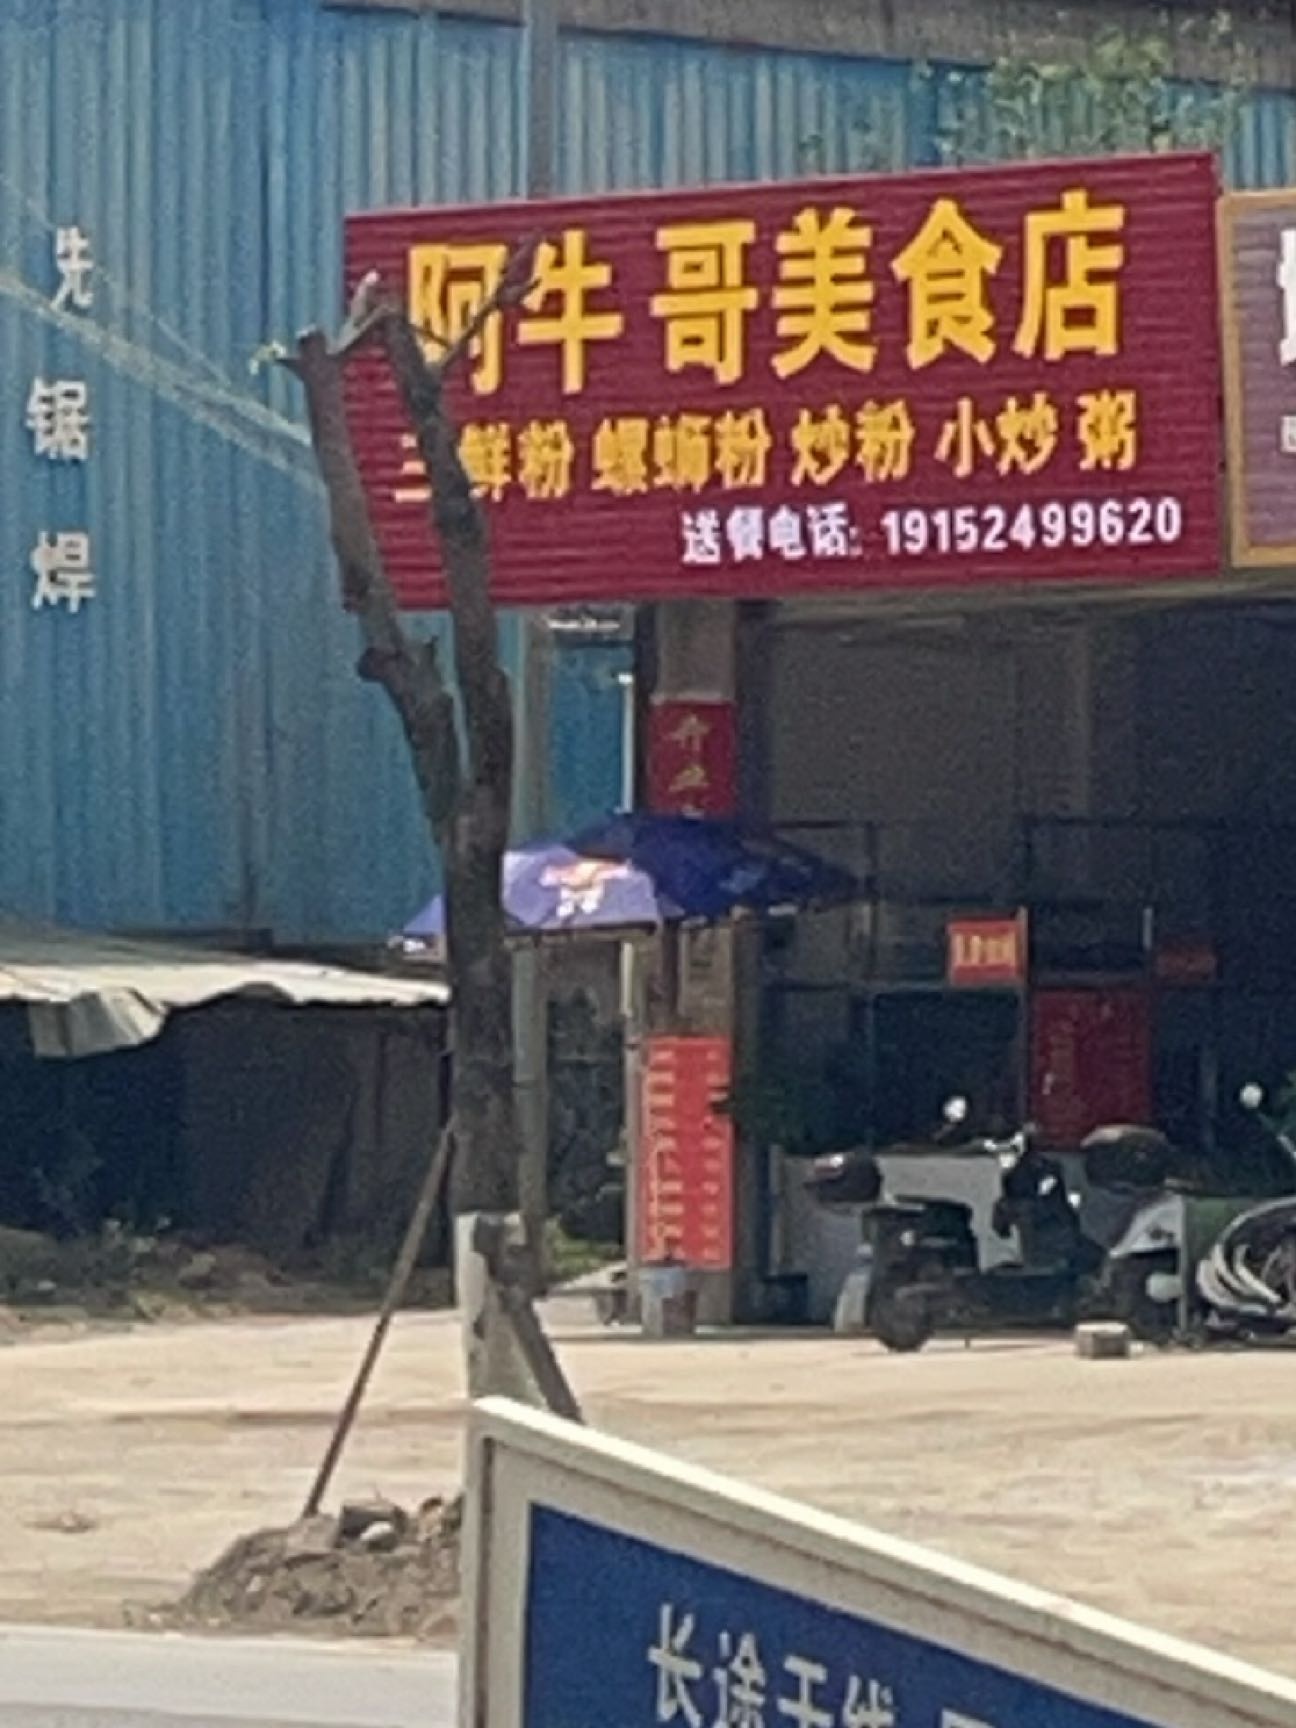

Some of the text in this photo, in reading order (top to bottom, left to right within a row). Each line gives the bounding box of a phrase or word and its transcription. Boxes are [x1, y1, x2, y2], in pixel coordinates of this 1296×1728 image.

[408, 190, 1125, 394] 阿牛哥美食店
[790, 399, 916, 487] 炒粉
